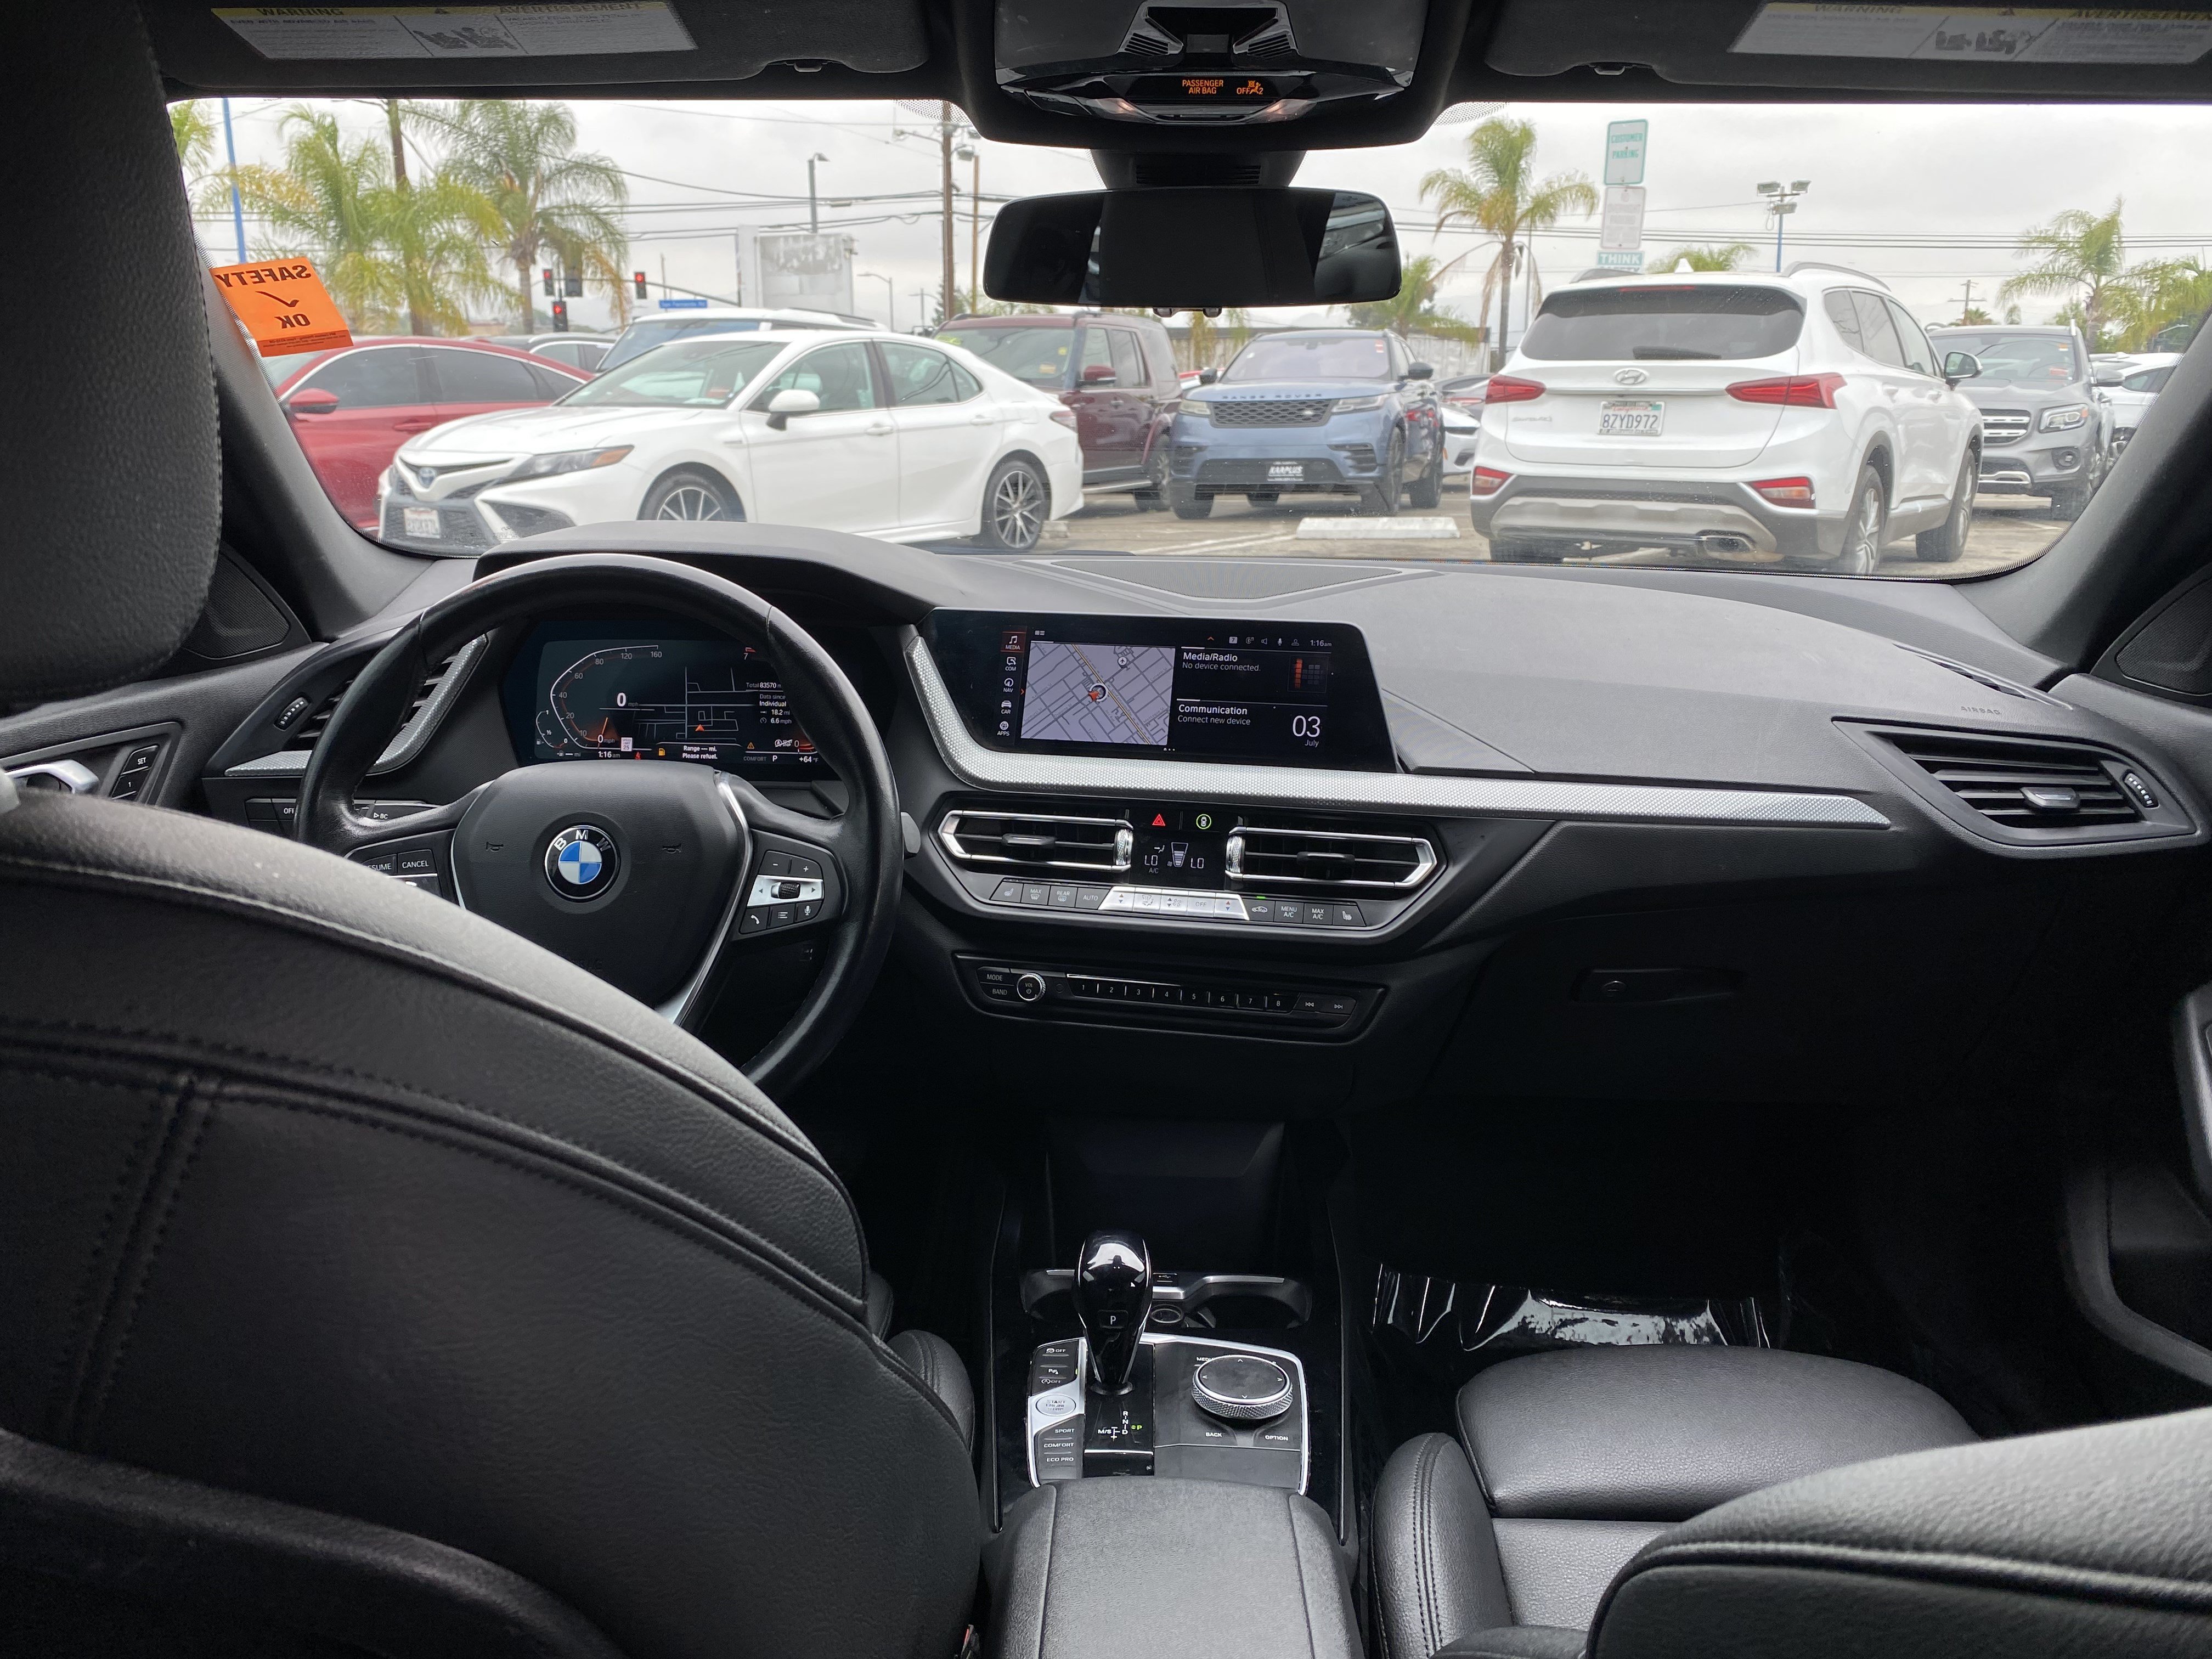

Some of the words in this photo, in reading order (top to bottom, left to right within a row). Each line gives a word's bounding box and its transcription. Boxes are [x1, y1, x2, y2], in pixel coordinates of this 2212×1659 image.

[1612, 149, 1639, 159] PARKING
[1600, 253, 1640, 264] THINK
[1602, 414, 1658, 428] 8ZYD972
[1183, 652, 1238, 662] Media/Radio
[617, 692, 626, 707] 0
[1178, 704, 1248, 715] Communication
[1960, 706, 2001, 715] AIRBAG
[1293, 715, 1321, 737] 03
[597, 735, 603, 743] 0
[554, 829, 611, 853] BMW
[402, 860, 430, 868] CANCEL
[1144, 855, 1158, 866] LO
[1190, 857, 1204, 868] LO
[368, 863, 392, 871] SUME
[1110, 1315, 1116, 1325] P
